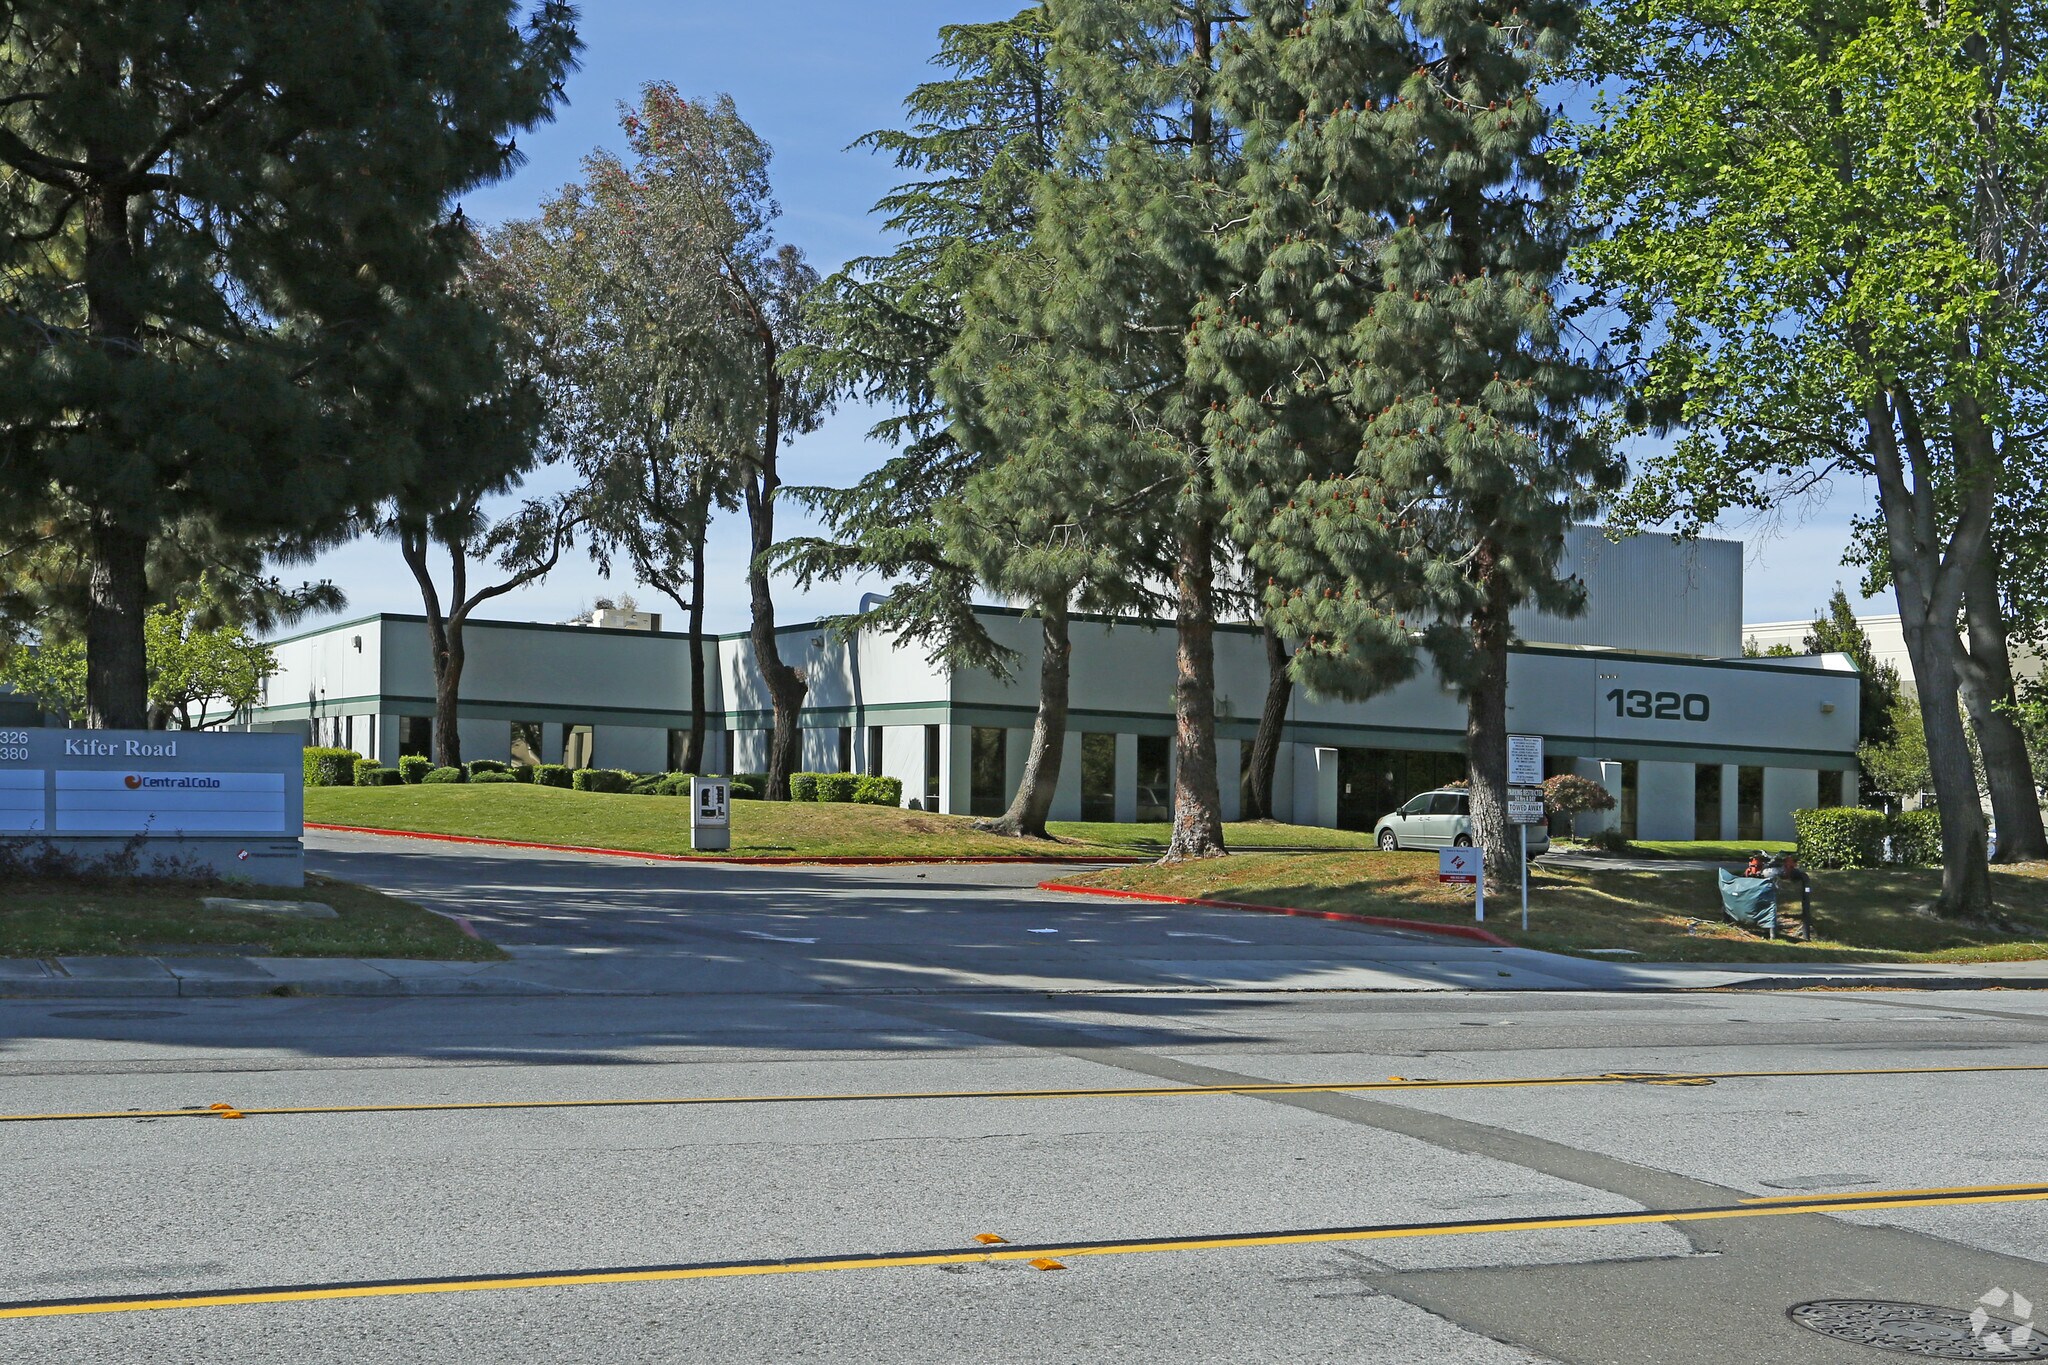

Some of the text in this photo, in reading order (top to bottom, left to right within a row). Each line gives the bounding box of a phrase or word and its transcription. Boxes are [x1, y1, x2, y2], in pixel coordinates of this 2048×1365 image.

[1606, 688, 1710, 722] 1320
[0, 731, 28, 744] 326
[0, 747, 28, 760] 380
[65, 739, 177, 757] Kifer Road
[142, 776, 220, 788] CentralColo
